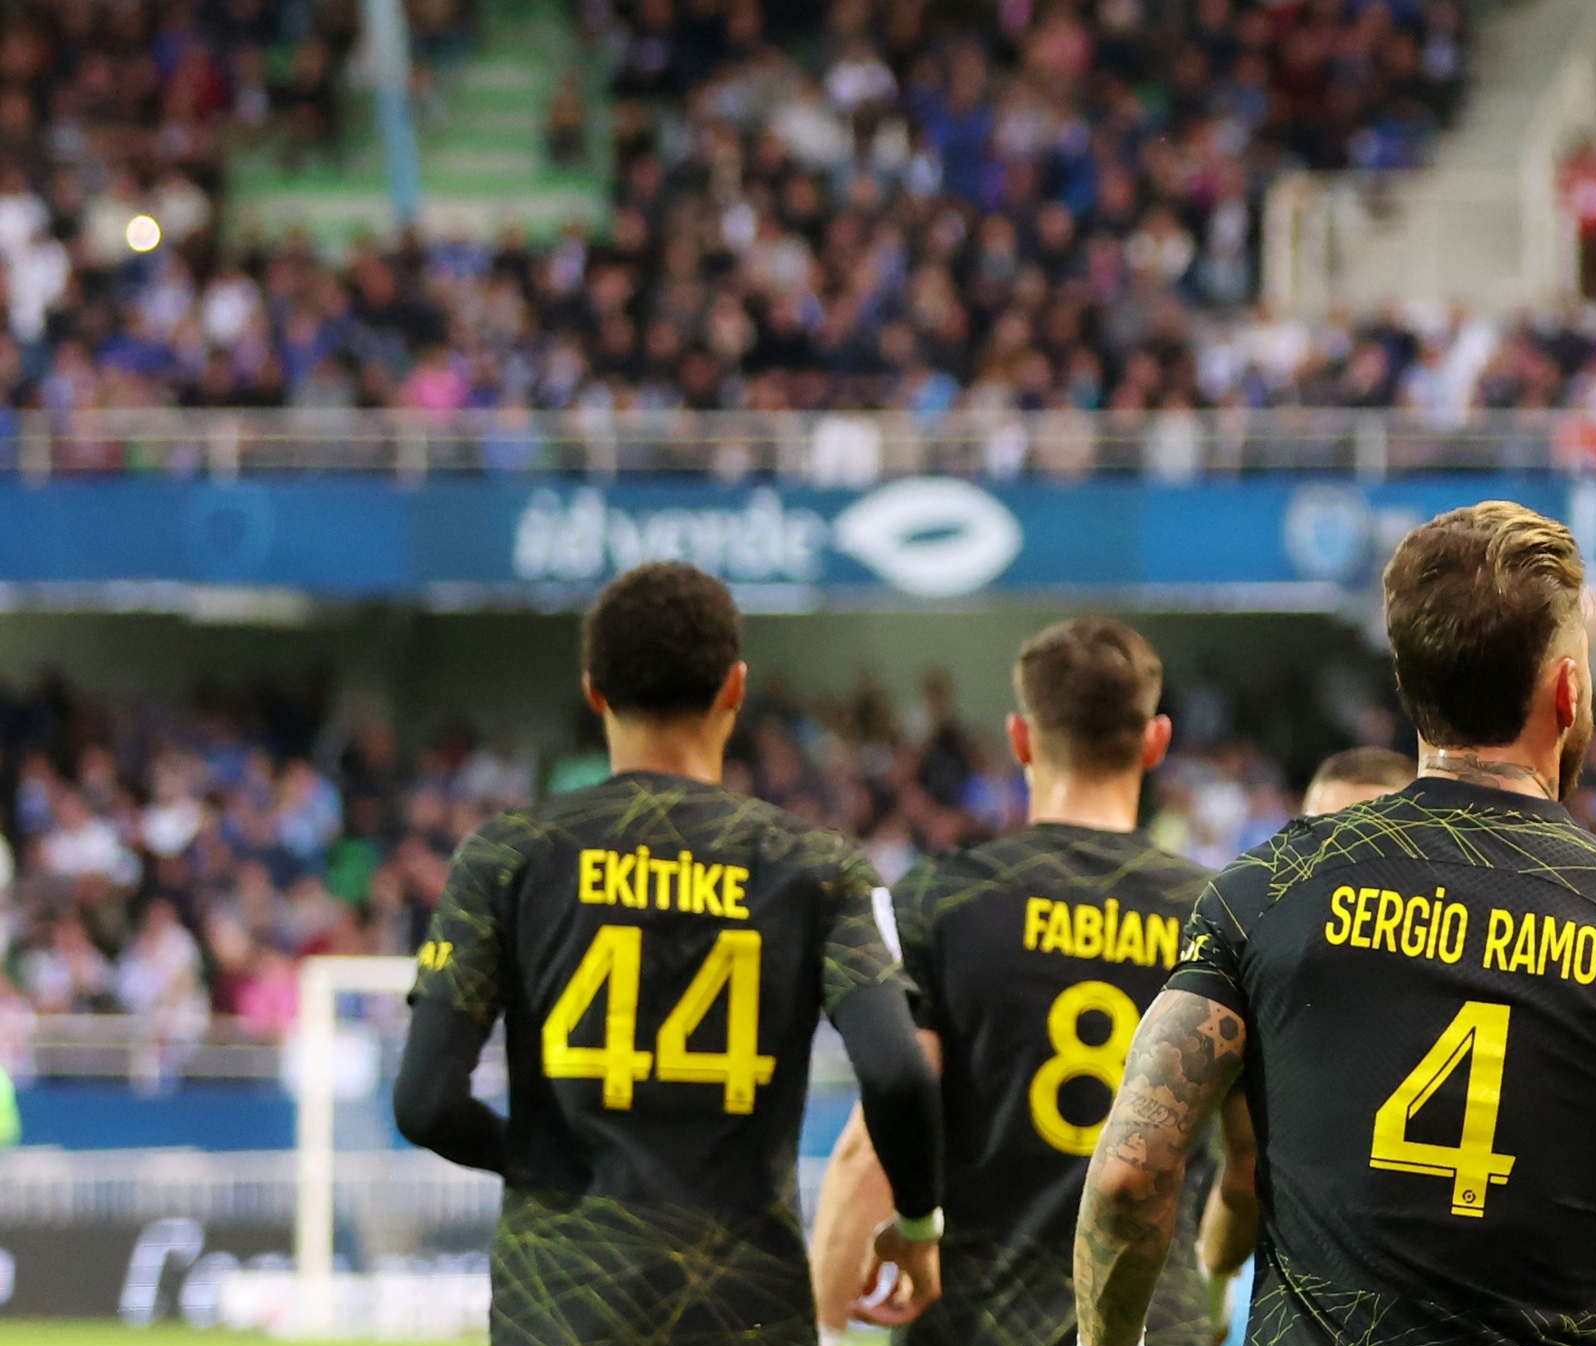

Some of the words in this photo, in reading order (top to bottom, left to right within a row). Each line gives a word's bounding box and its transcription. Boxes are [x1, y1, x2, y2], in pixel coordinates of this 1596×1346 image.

[541, 925, 776, 1115] 44
[1029, 980, 1141, 1157] 8
[1369, 1001, 1516, 1218] 4
